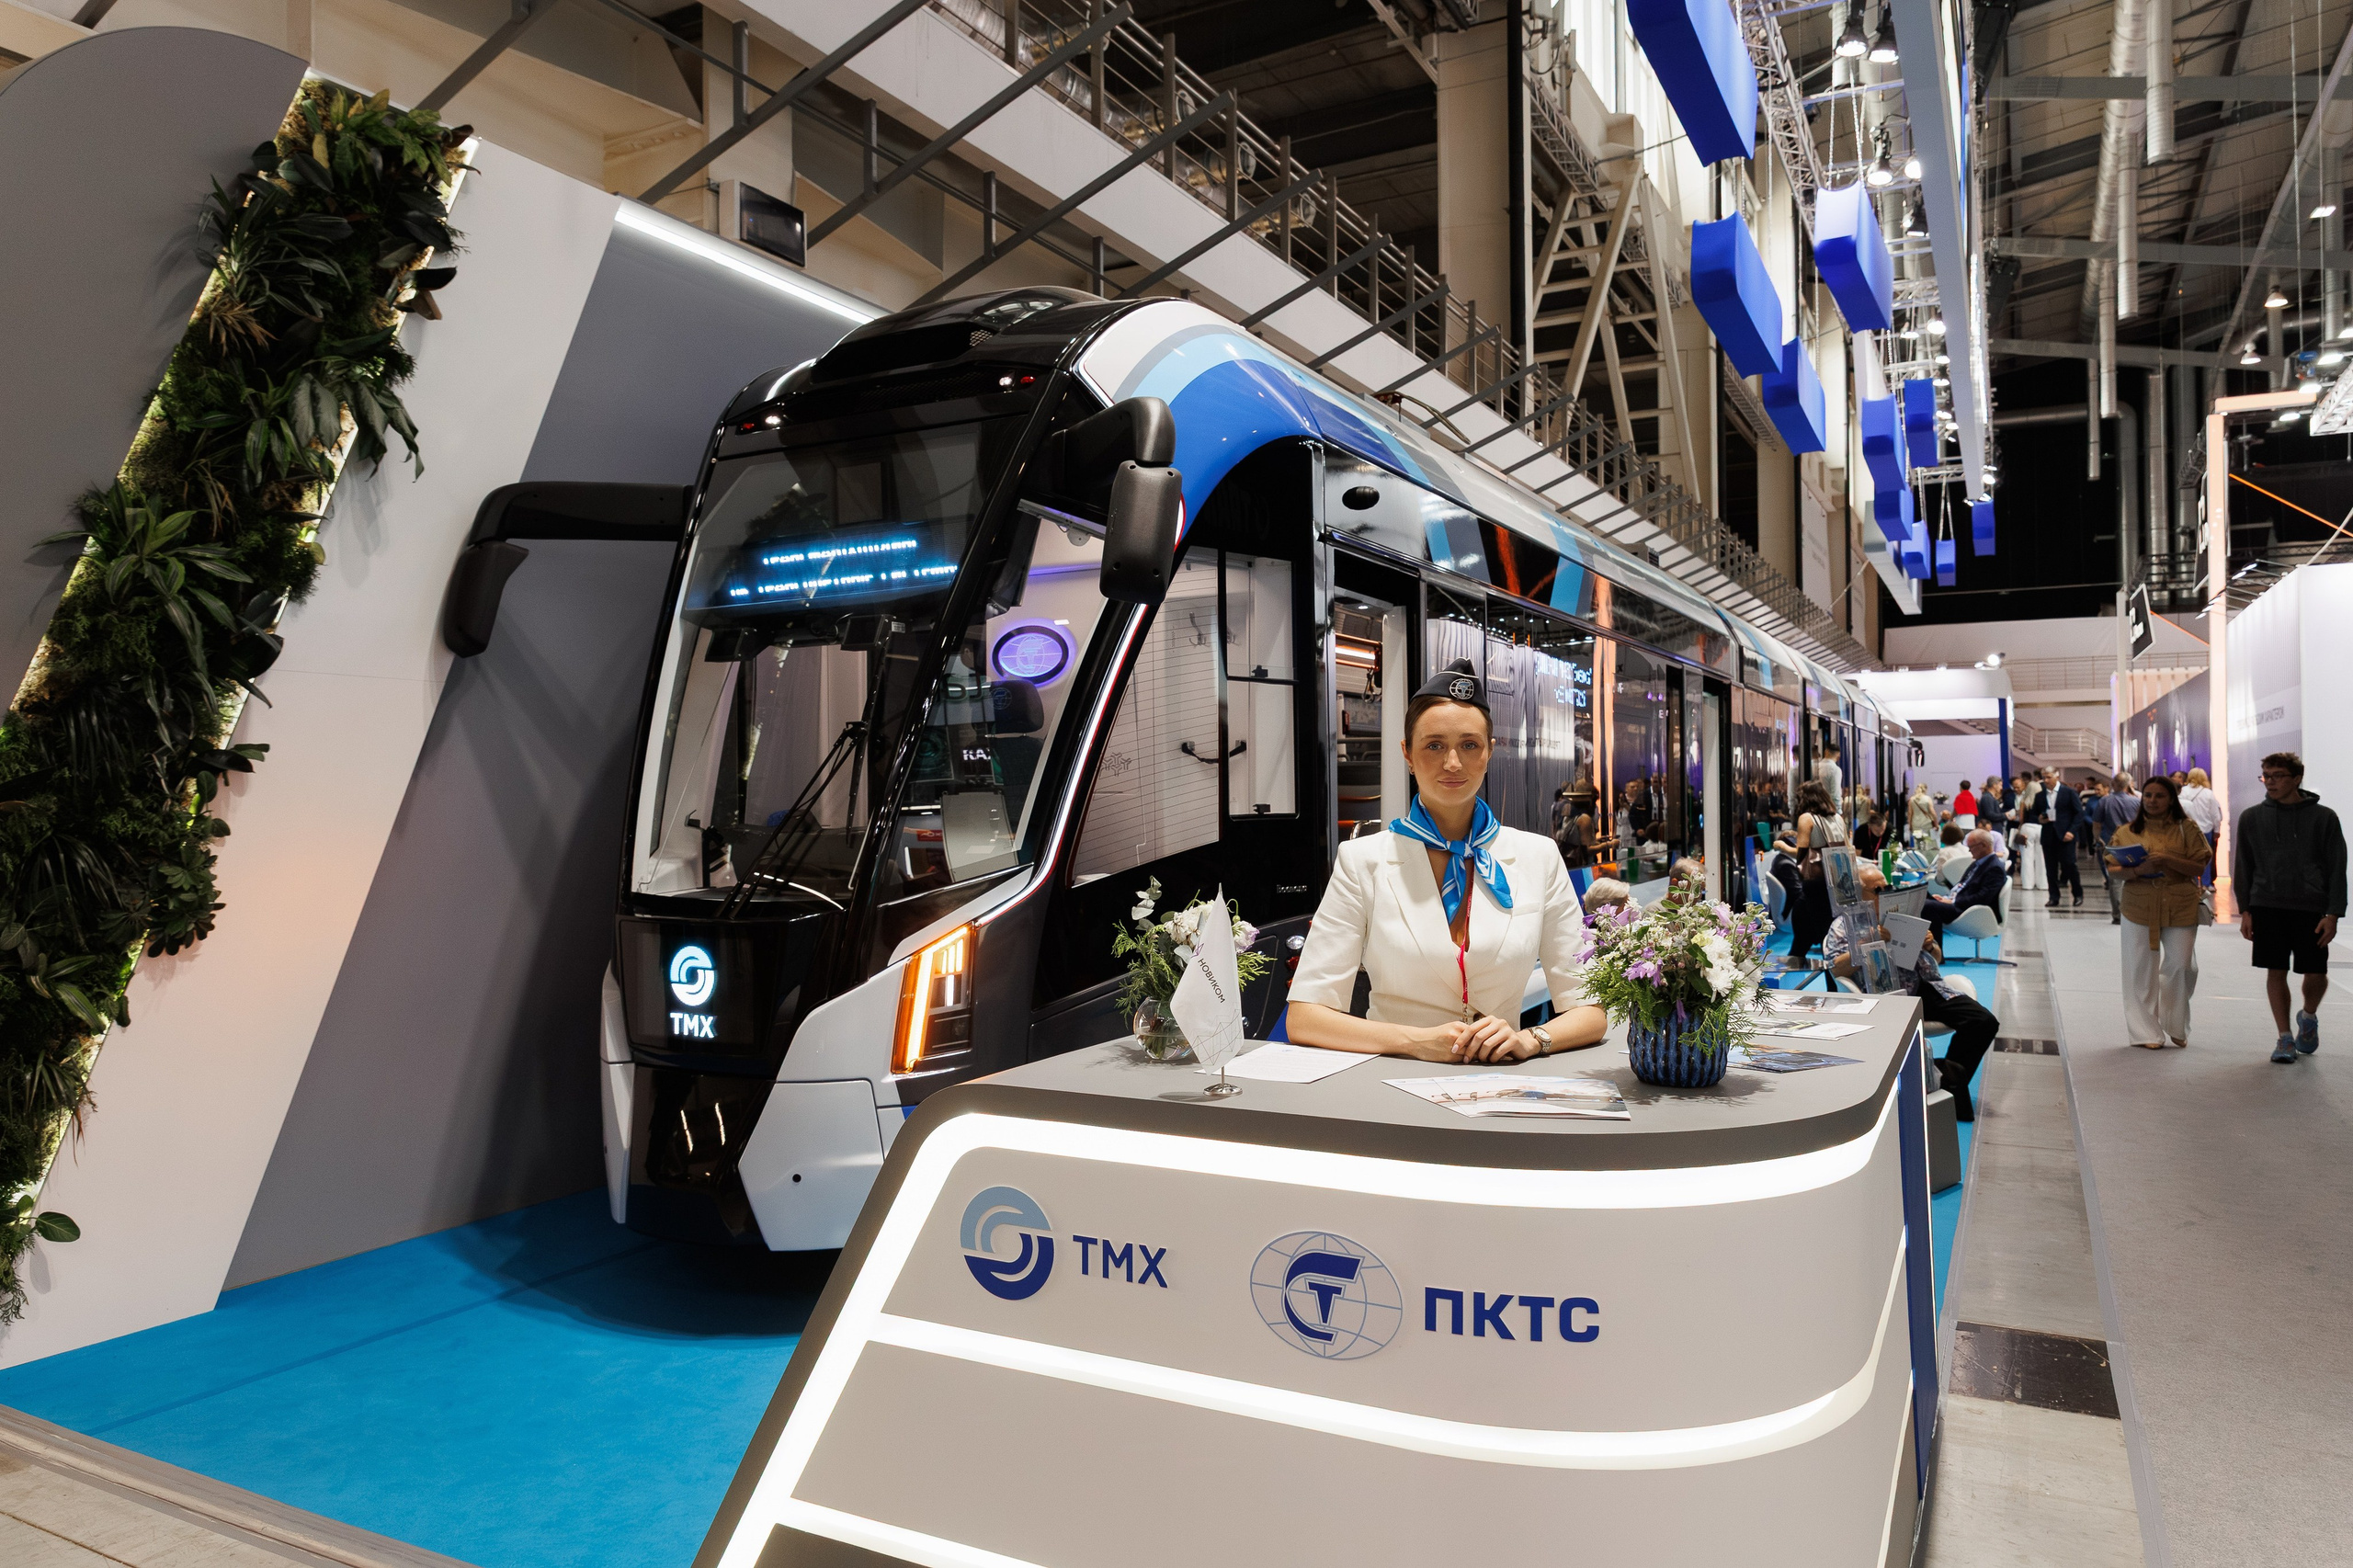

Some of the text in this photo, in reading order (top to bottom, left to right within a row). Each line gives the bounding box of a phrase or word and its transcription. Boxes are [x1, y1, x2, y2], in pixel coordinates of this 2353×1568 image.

[1197, 959, 1225, 1003] НОВИКОМ
[670, 1012, 714, 1039] ТМХ
[1072, 1233, 1168, 1289] ТМХ
[1424, 1286, 1600, 1343] ПКТС
